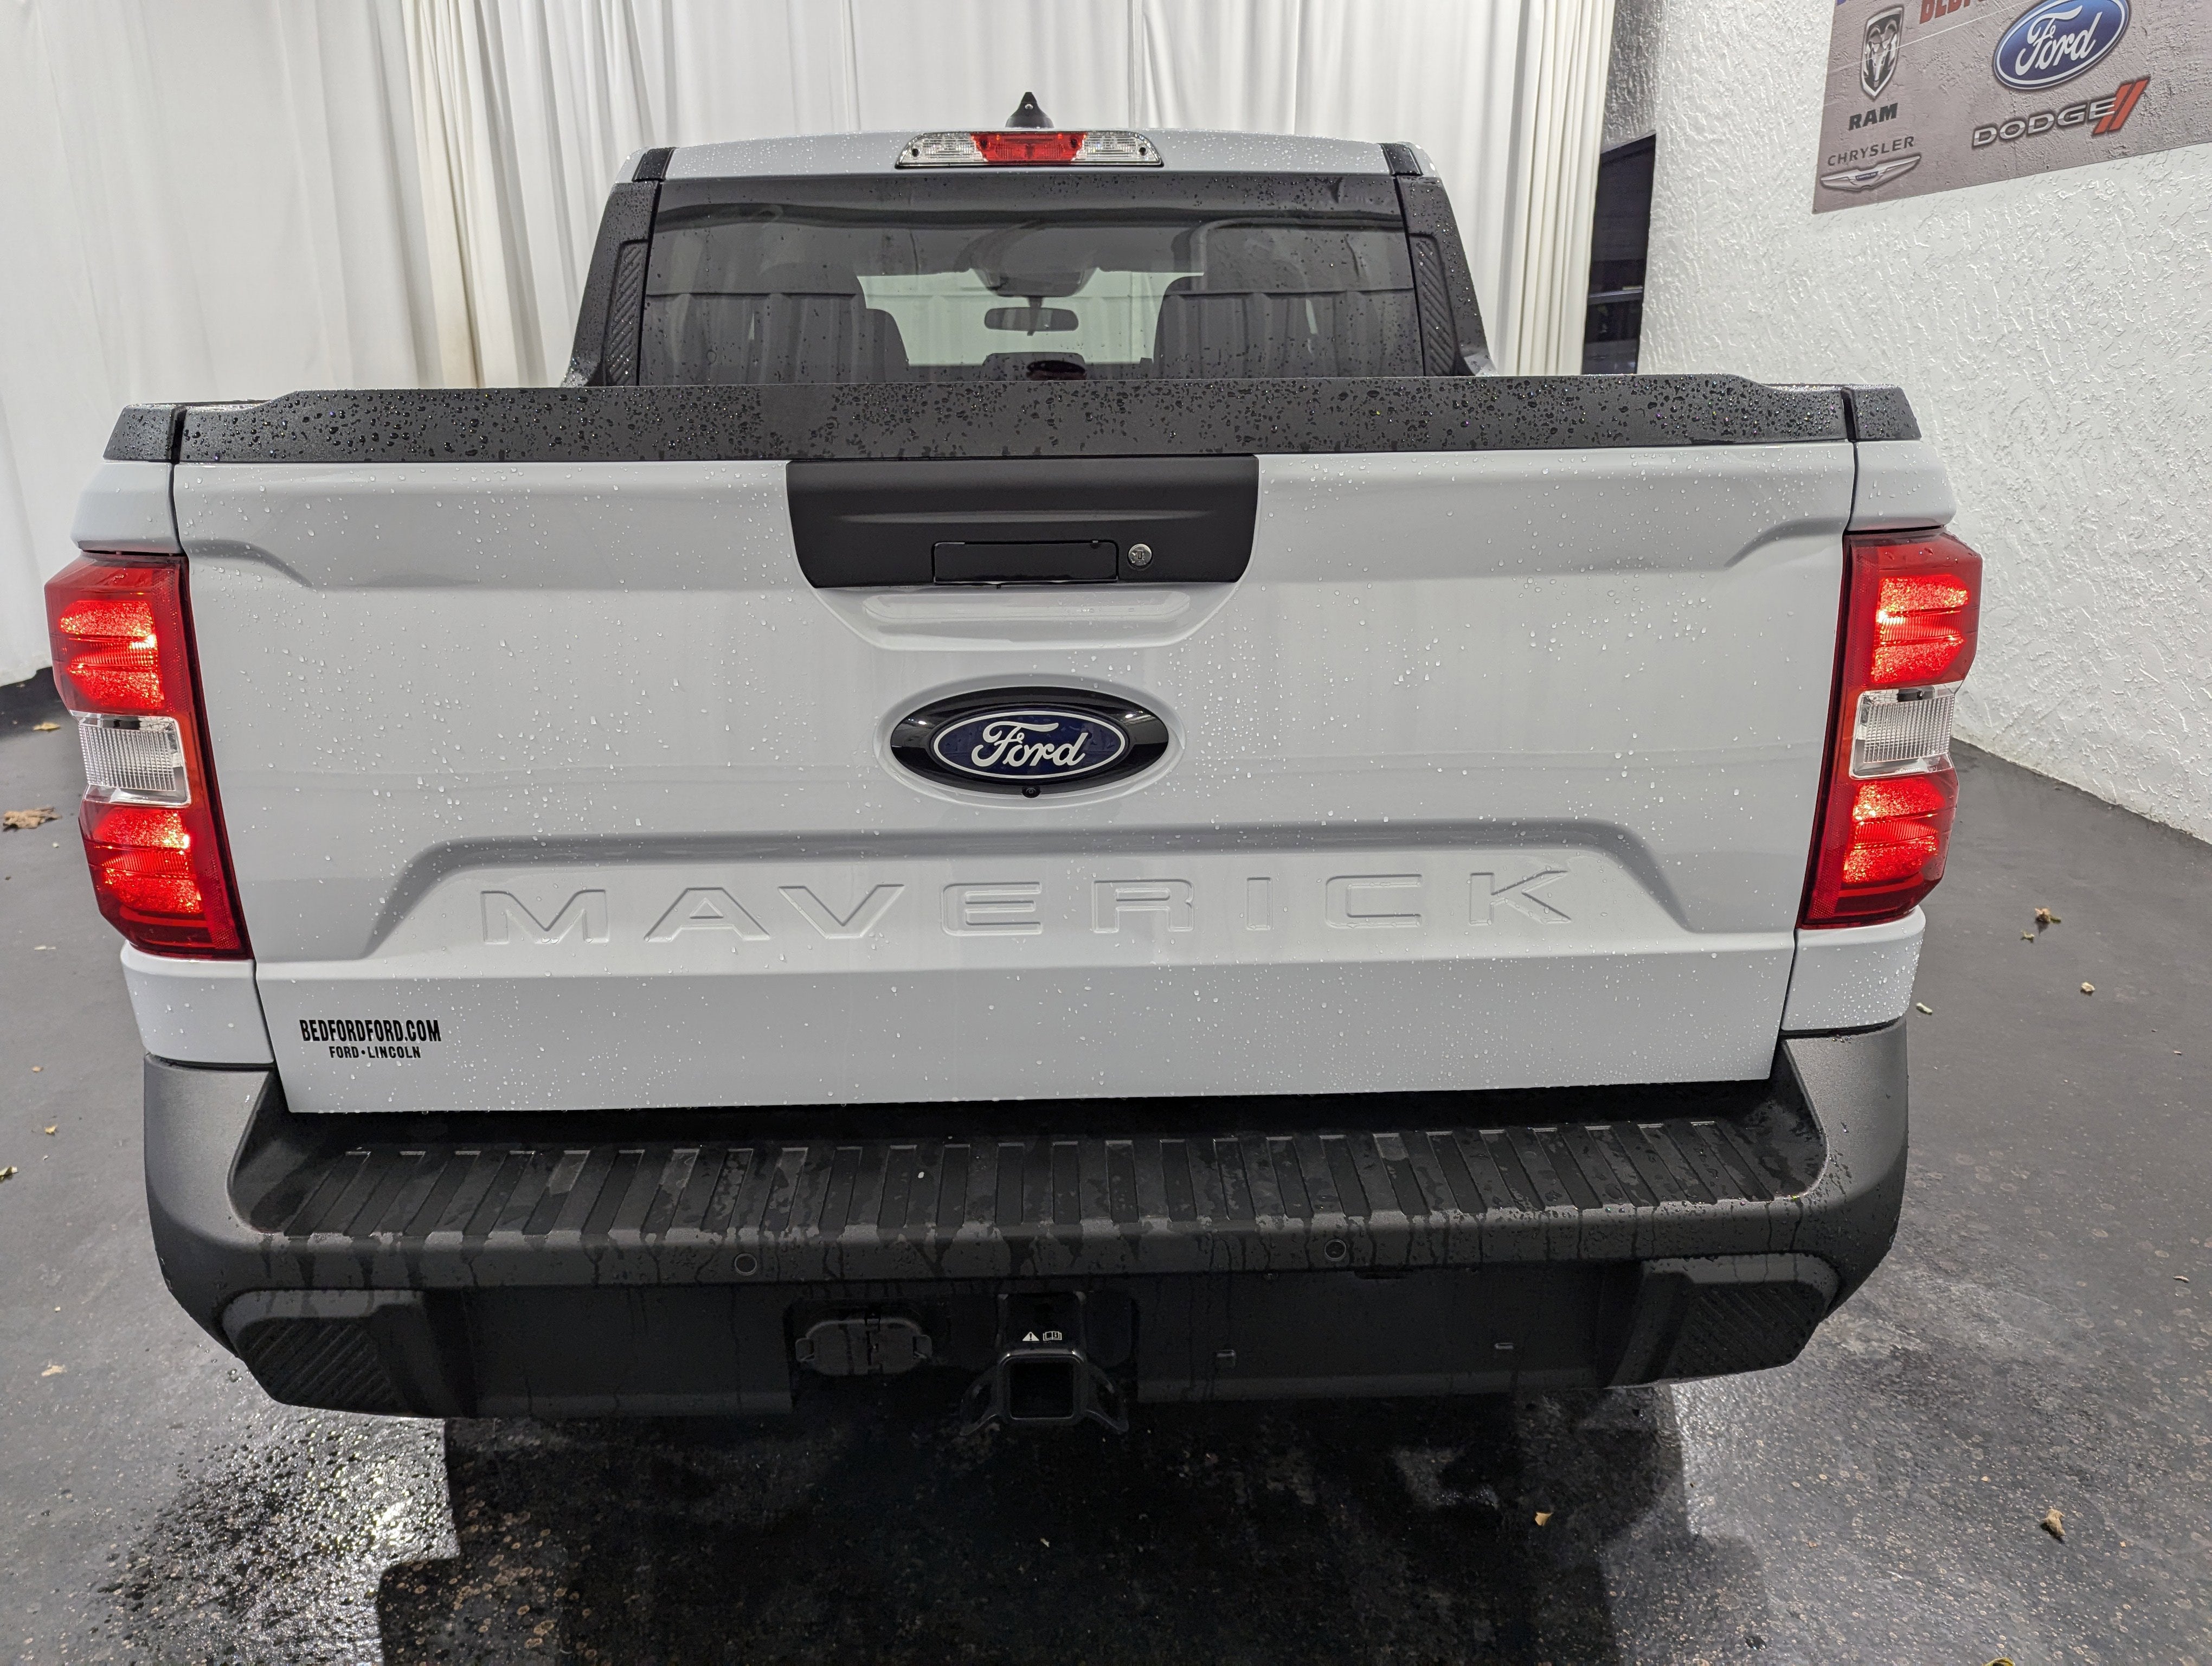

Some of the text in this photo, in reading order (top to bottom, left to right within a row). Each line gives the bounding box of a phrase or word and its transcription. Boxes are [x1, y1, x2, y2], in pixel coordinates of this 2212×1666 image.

[2015, 5, 2102, 76] Ford
[1848, 102, 1898, 131] RAM
[1973, 97, 2117, 147] DODGE
[1828, 136, 1914, 166] CHRYSLER
[971, 721, 1089, 767] Ford
[479, 869, 1572, 946] MAVERICK
[299, 1020, 442, 1042] BEDFORDFORD.COM
